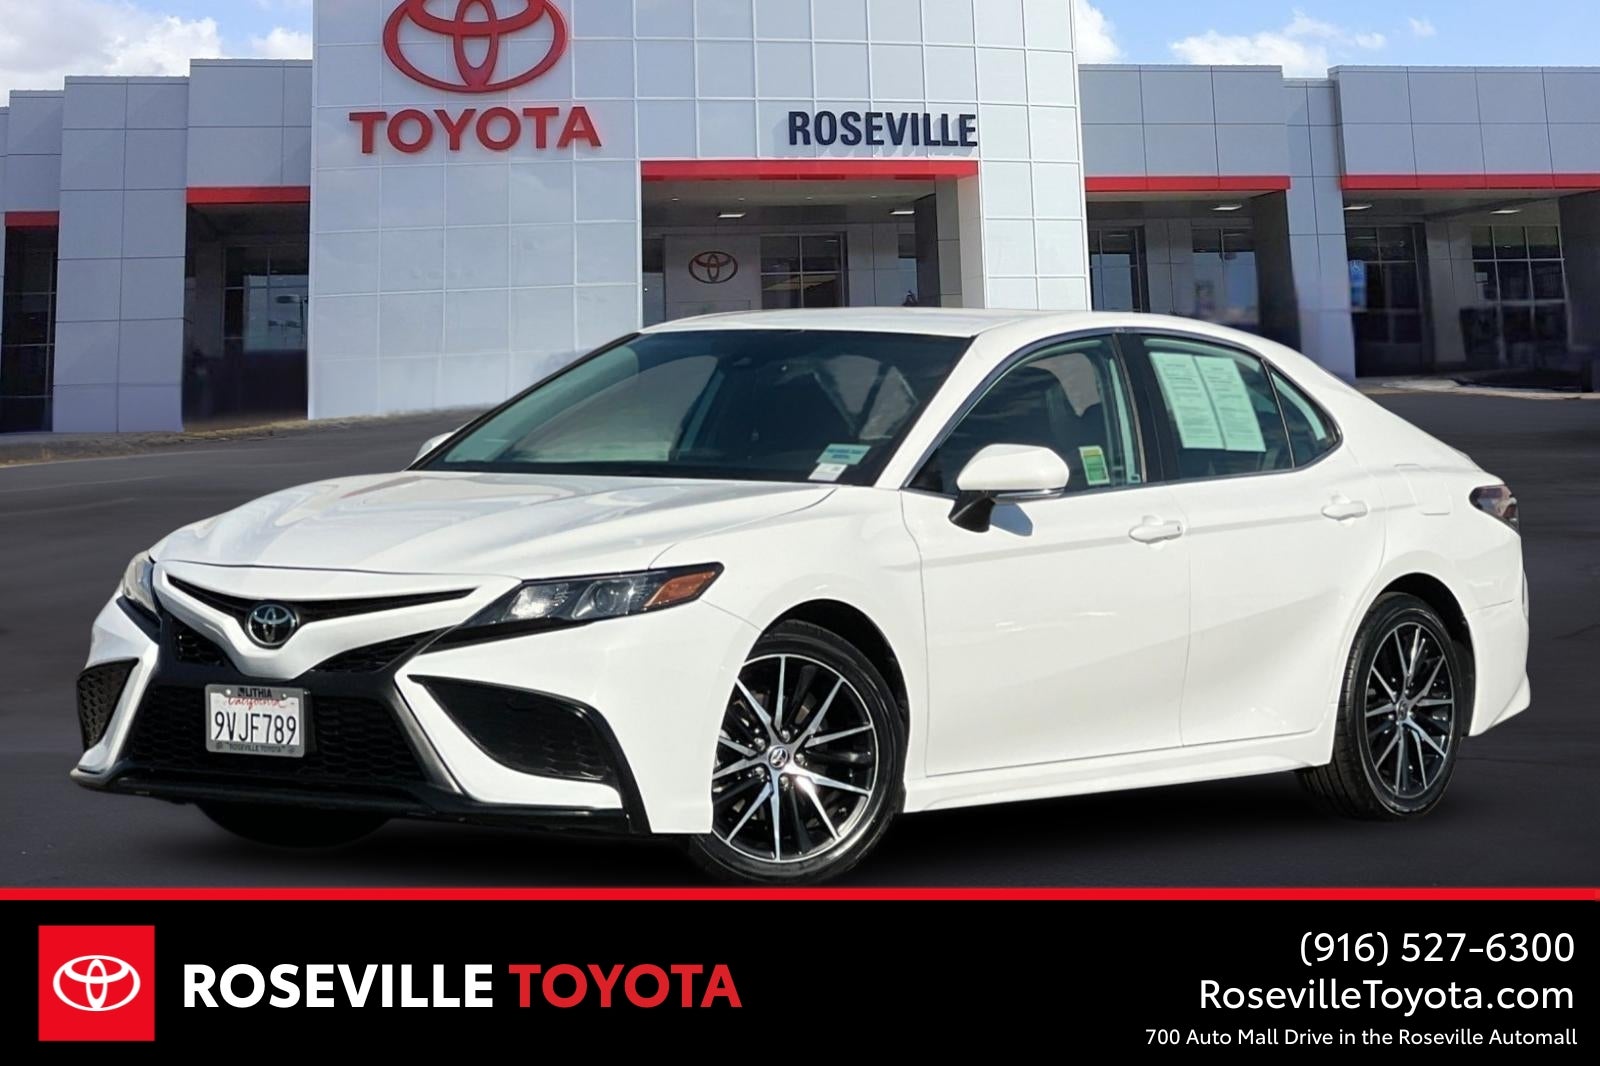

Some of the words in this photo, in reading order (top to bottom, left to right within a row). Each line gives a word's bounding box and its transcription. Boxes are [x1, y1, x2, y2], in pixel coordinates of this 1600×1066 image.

[349, 106, 602, 154] TOYOTA
[788, 110, 978, 147] ROSEVILLE
[214, 711, 297, 745] 9VJF789
